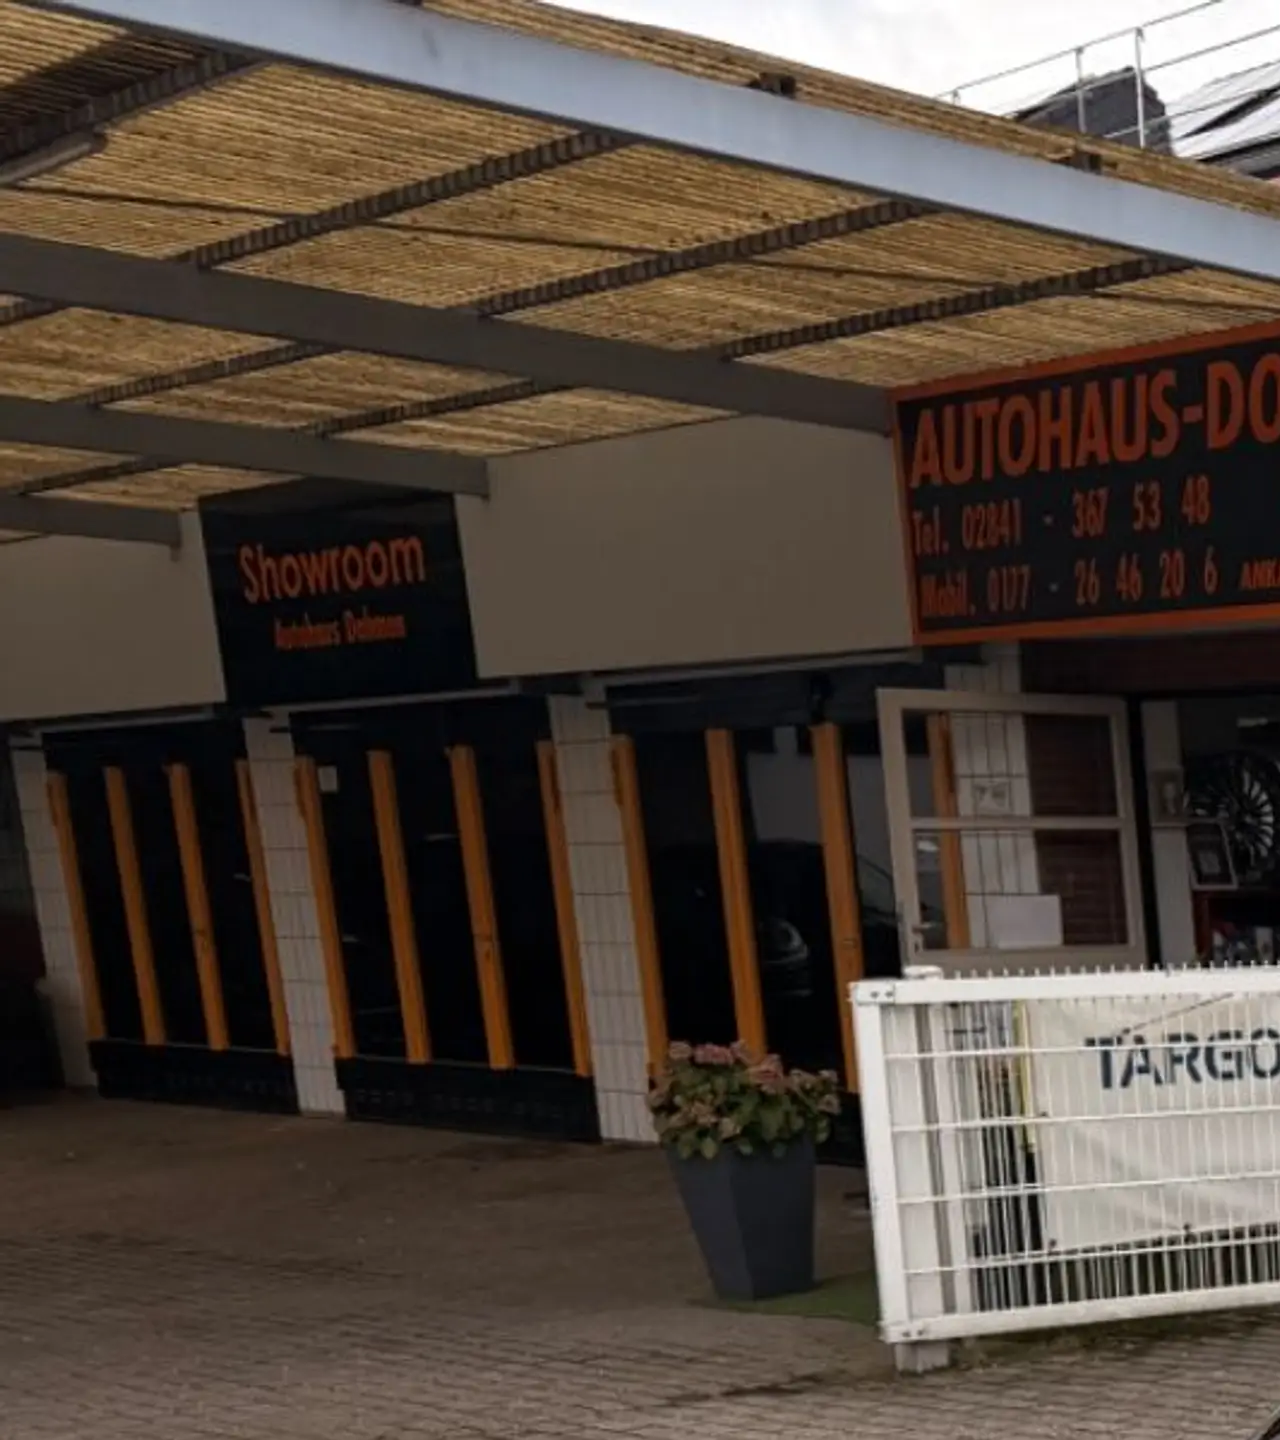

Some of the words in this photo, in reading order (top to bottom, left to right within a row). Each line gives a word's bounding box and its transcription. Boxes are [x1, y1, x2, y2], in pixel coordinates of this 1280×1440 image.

[912, 505, 949, 555] Tel.
[961, 497, 1022, 550] 02841
[1133, 481, 1162, 530] 53
[1182, 475, 1210, 525] 48
[239, 536, 426, 603] Showroom
[1075, 557, 1100, 605] 26
[1116, 551, 1142, 601] 46
[1160, 549, 1186, 598] 20
[1204, 546, 1218, 595] 6
